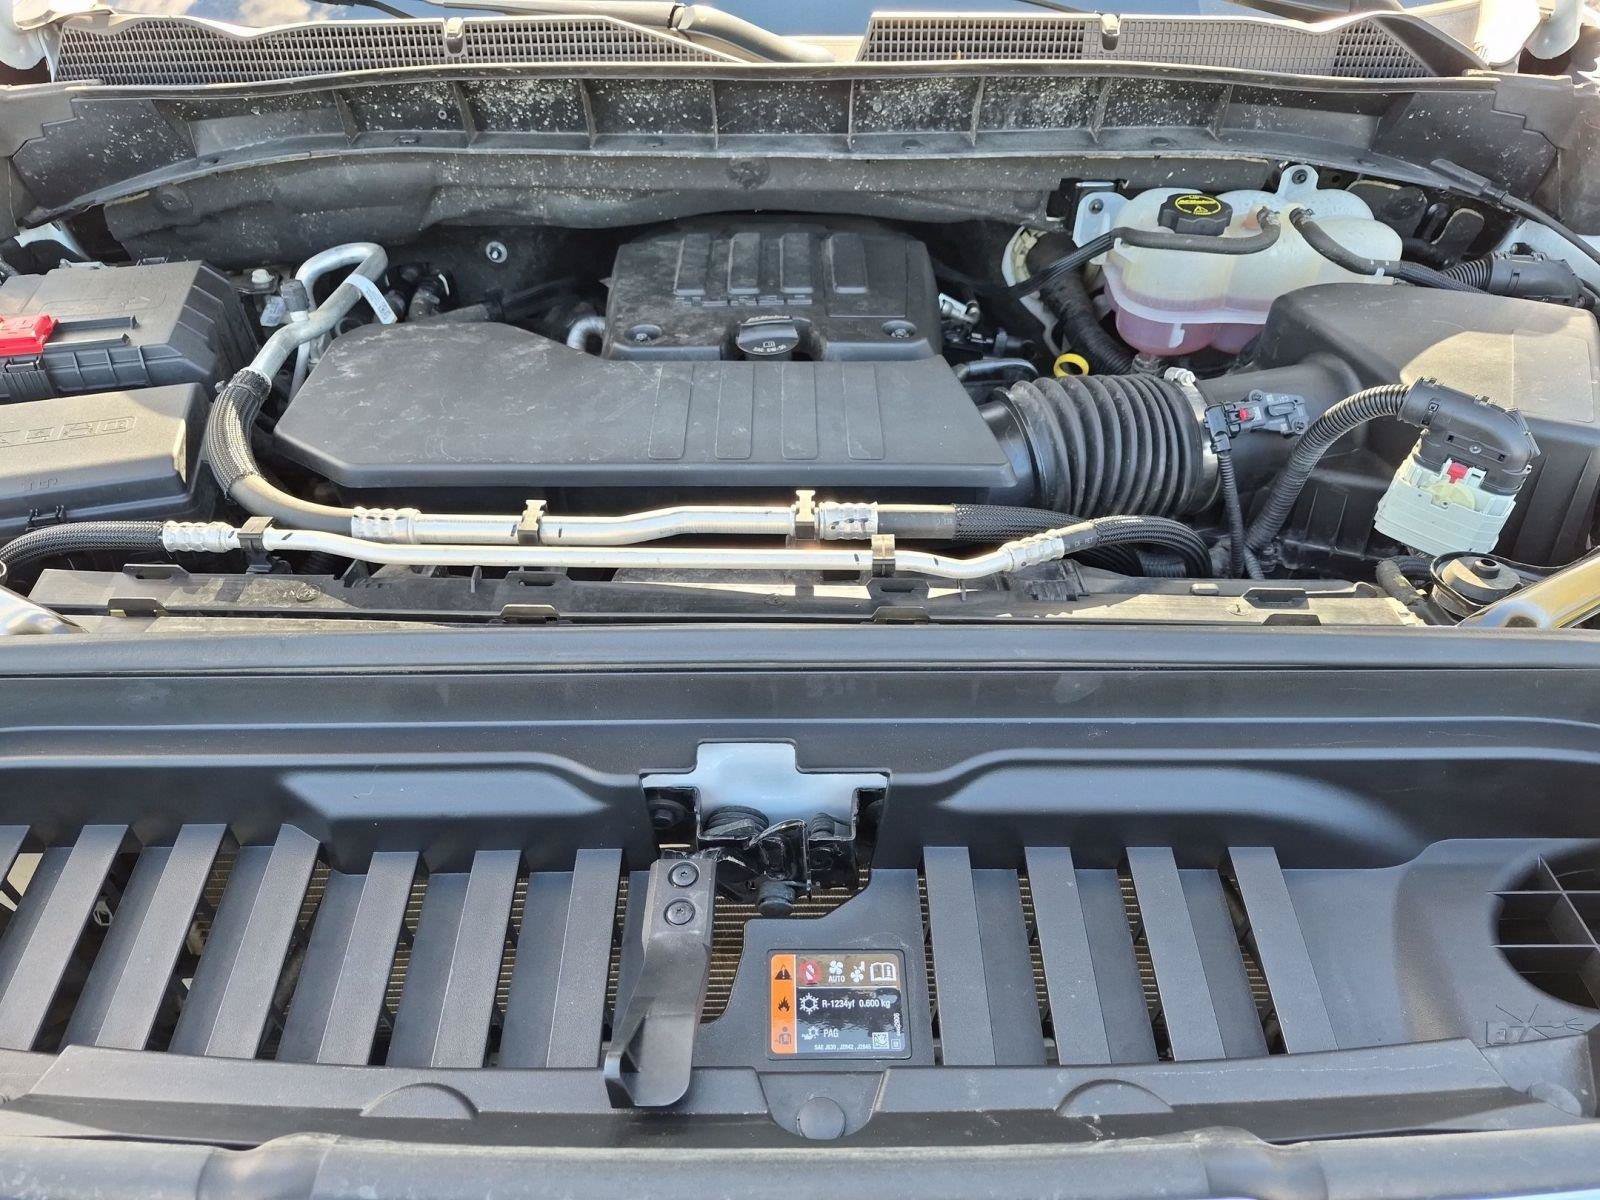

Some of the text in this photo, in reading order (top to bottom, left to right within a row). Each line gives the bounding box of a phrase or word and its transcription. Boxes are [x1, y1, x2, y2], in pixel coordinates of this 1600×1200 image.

[828, 975, 846, 983] AUTO
[821, 999, 891, 1009] R-1234yf 0.600 kg
[823, 1028, 839, 1038] PAG
